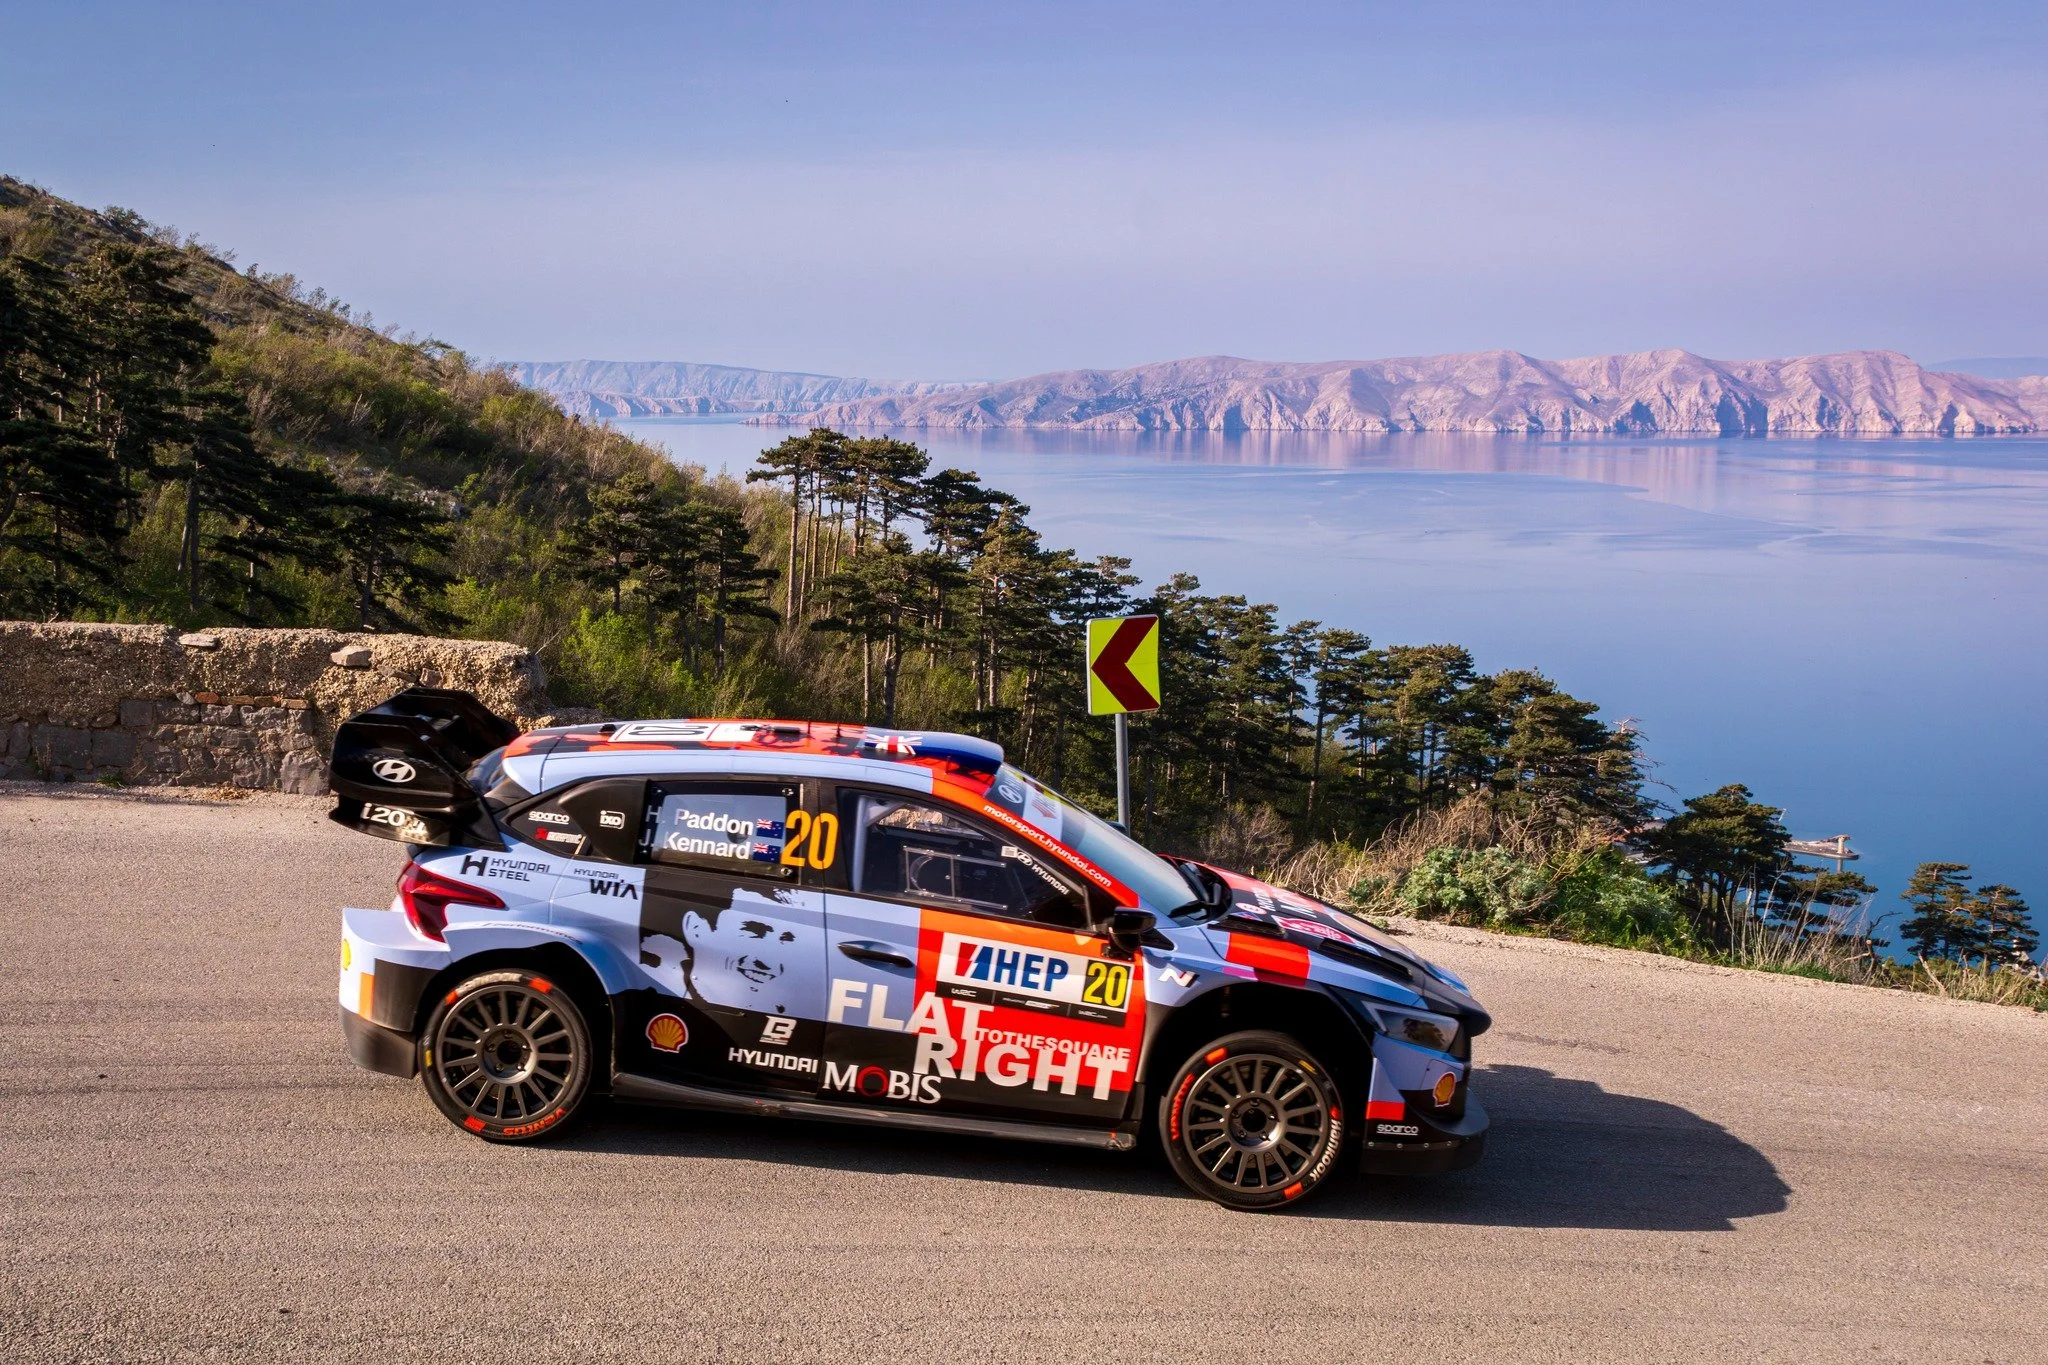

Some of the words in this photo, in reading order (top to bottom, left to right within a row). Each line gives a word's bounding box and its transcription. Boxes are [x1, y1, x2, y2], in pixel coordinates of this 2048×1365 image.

[528, 810, 570, 823] sparco
[600, 810, 622, 826] ixo
[674, 808, 754, 836] Paddon
[662, 831, 750, 860] Kennard
[780, 809, 839, 870] 20
[983, 805, 1112, 887] motorsport.hyundai.com
[488, 868, 531, 882] STEEL
[491, 858, 551, 874] HYUNDAI
[573, 868, 619, 880] HYUNDAI
[1031, 864, 1070, 895] HYUNDAI
[1082, 961, 1129, 1009] 20
[828, 978, 994, 1042] FLAT
[976, 1027, 1131, 1062] TOTHESQUARE
[728, 1047, 819, 1074] HYUNDAI
[913, 1032, 1129, 1101] RIGHT
[824, 1061, 942, 1105] MOBIS
[1377, 1123, 1419, 1135] sparco
